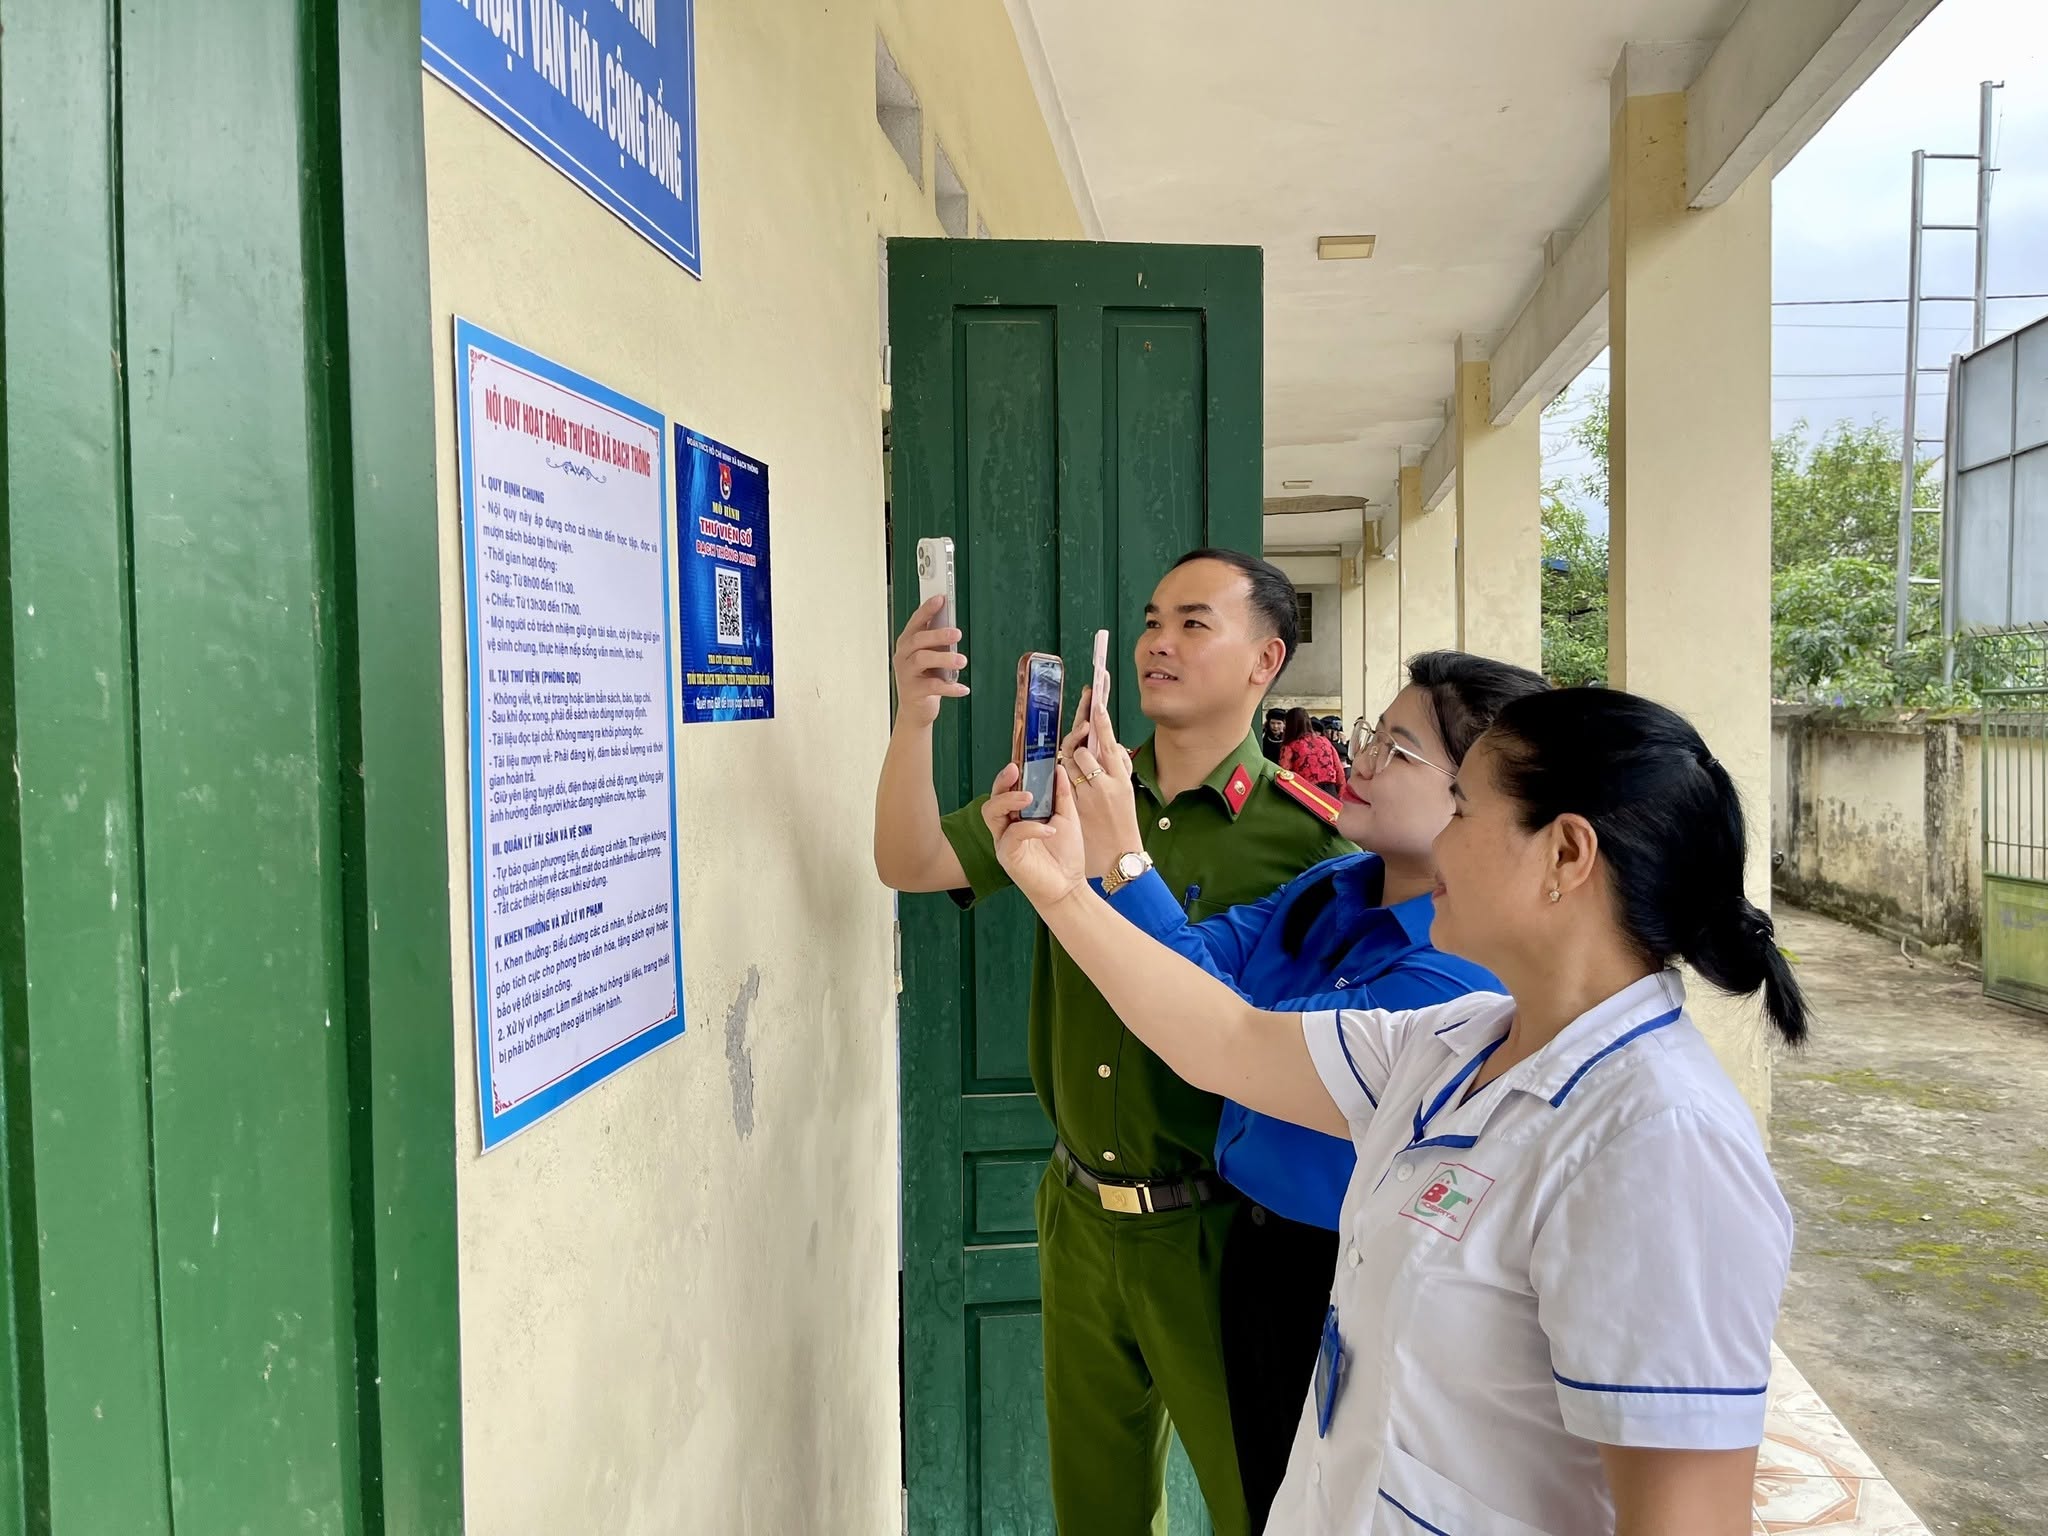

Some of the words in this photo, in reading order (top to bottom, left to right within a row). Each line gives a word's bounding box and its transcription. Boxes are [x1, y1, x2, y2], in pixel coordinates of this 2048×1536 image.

[568, 9, 604, 132] HÓA
[605, 44, 646, 169] CỘNG
[647, 77, 683, 202] ĐỒNG
[485, 383, 501, 430] NỘI
[503, 395, 520, 431] QUY
[522, 402, 544, 444] HOẠT
[545, 407, 567, 450] ĐỘNG
[568, 420, 583, 453] THƯ
[583, 423, 600, 464] VIỆN
[487, 476, 502, 492] QUY
[503, 480, 520, 498] ĐỊNH
[521, 486, 544, 504] CHUNG
[502, 507, 517, 523] quy
[712, 499, 722, 516] MÔ
[482, 525, 504, 540] mượn
[505, 528, 522, 543] sách
[522, 531, 536, 546] báo
[699, 515, 718, 539] THƯ
[720, 521, 739, 548] VIỆN
[739, 525, 752, 548] SỐ
[487, 545, 504, 561] Thời
[505, 550, 521, 566] gian
[521, 553, 537, 569] hoạt
[538, 556, 557, 573] động:
[696, 539, 716, 561] BẠCH
[716, 543, 738, 563] THÔNG
[490, 569, 512, 588] Sáng:
[522, 575, 540, 590] 8h00
[490, 592, 515, 607] Chiều:
[526, 597, 546, 611] 13h30
[490, 615, 504, 631] Mọi
[505, 617, 526, 633] người
[536, 620, 554, 633] trách
[497, 638, 513, 651] sinh
[513, 639, 538, 656] chung,
[538, 641, 553, 656] thực
[510, 668, 524, 682] THƯ
[524, 669, 540, 686] VIỆN
[541, 670, 565, 684] (PHÒNG
[493, 692, 517, 708] Không
[491, 709, 506, 723] Sau
[531, 711, 550, 724] xong,
[520, 754, 541, 767] mượn
[488, 773, 505, 790] gian
[505, 771, 524, 784] hoàn
[493, 790, 507, 804] Giữ
[522, 787, 537, 802] lặng
[537, 784, 554, 800] tuyệt
[489, 808, 504, 823] ảnh
[504, 807, 528, 820] hưởng
[542, 799, 562, 816] người
[503, 834, 523, 854] QUẢN
[544, 827, 558, 845] SẢN
[507, 862, 521, 877] bảo
[522, 858, 539, 876] quản
[540, 854, 564, 872] phương
[492, 883, 509, 899] chịu
[509, 878, 528, 894] trách
[528, 873, 549, 889] nhiệm
[522, 889, 538, 907] thiết
[545, 887, 560, 902] điện
[503, 927, 523, 946] KHEN
[524, 918, 550, 939] THƯỞNG
[503, 955, 523, 971] Khen
[524, 944, 551, 963] thưởng:
[552, 934, 567, 952] Biểu
[495, 980, 511, 999] góp
[512, 973, 526, 990] tích
[527, 969, 541, 984] cực
[541, 964, 555, 977] cho
[496, 1002, 511, 1019] bảo
[533, 1007, 555, 1028] phạm:
[555, 999, 570, 1014] Làm
[507, 1040, 524, 1062] phải
[536, 1025, 560, 1045] thường
